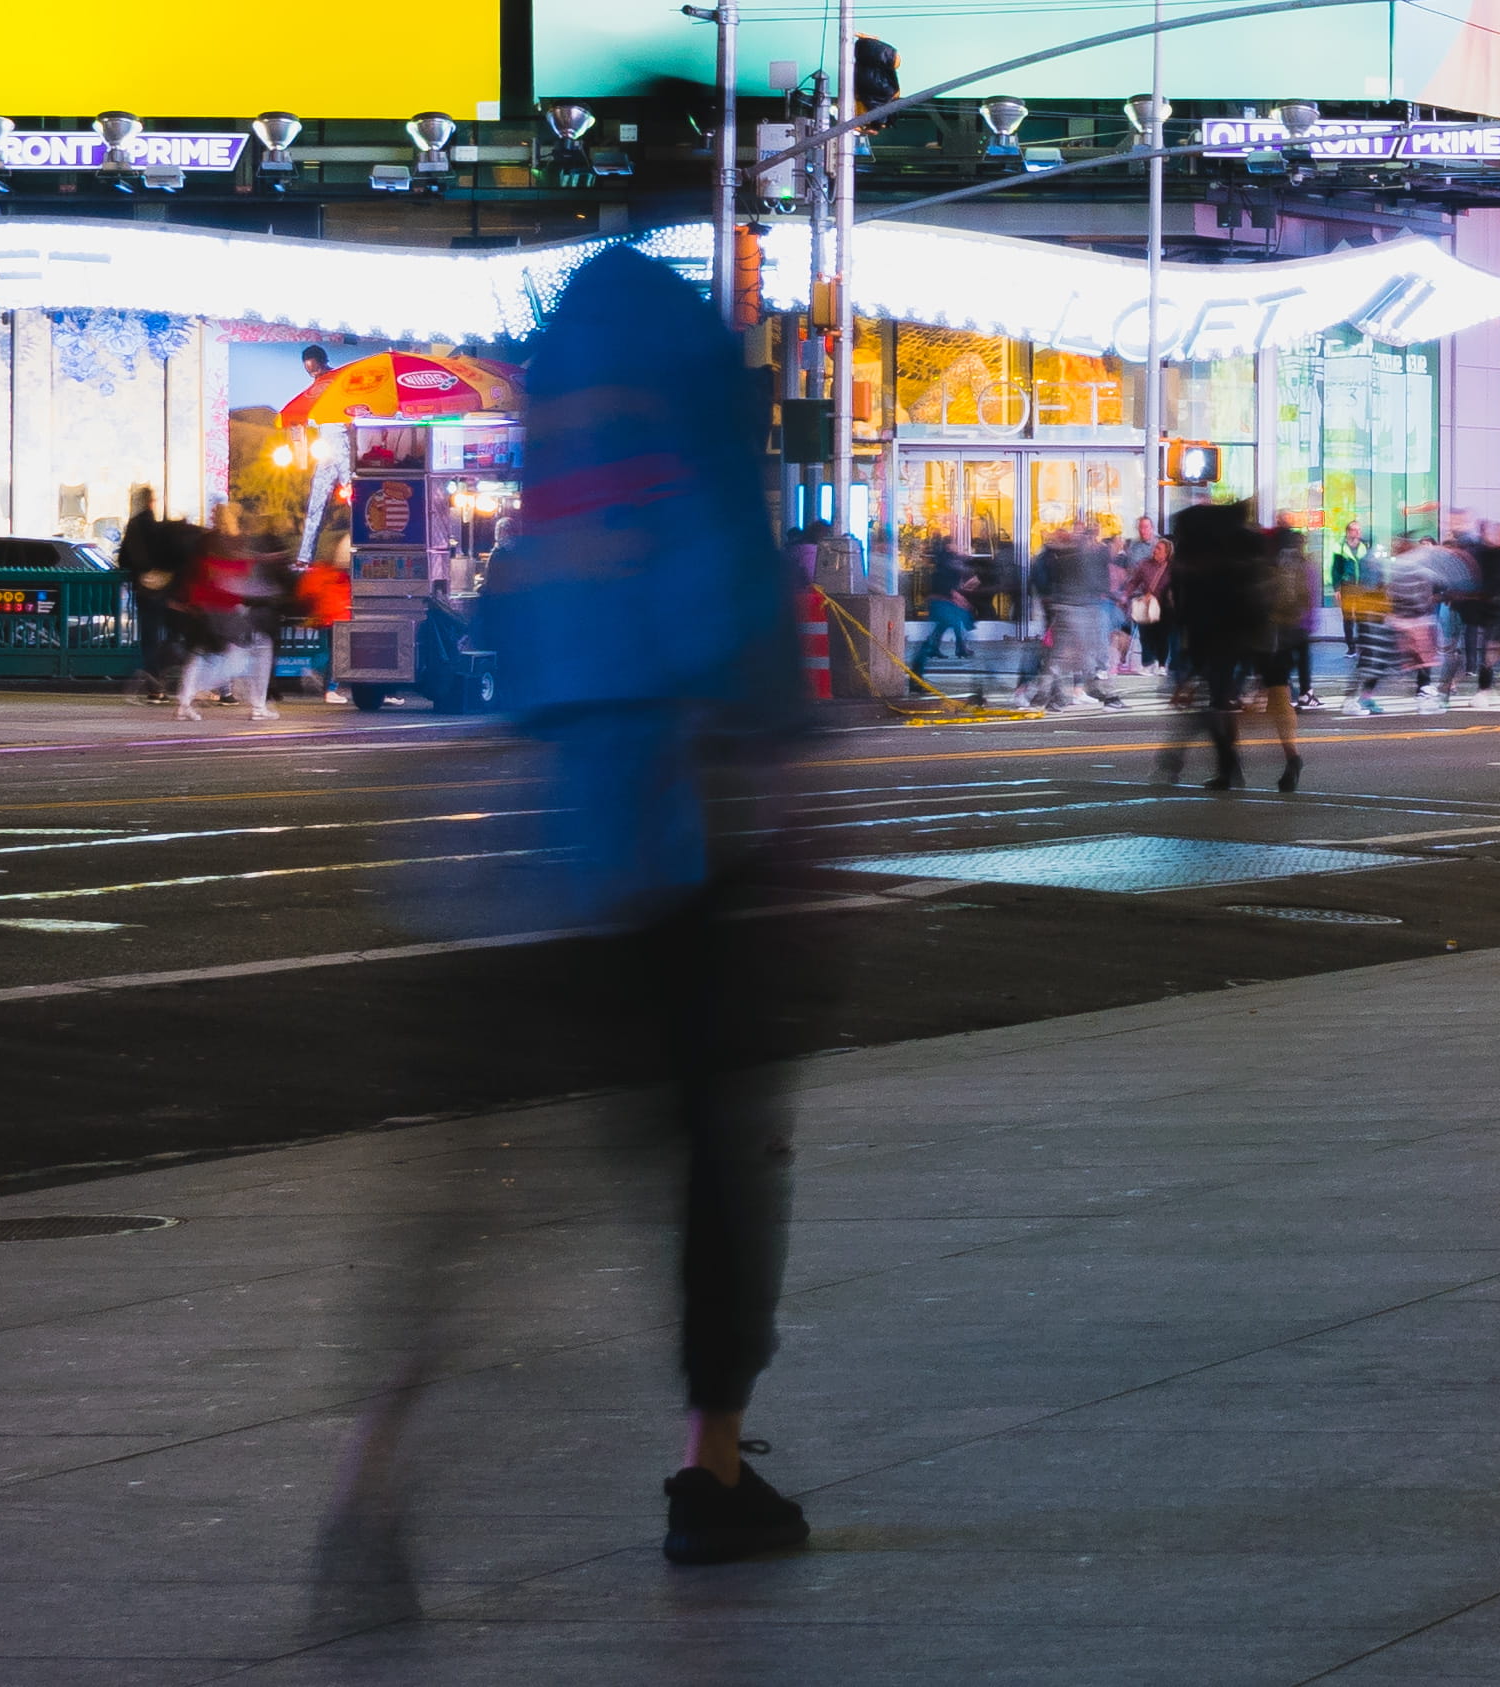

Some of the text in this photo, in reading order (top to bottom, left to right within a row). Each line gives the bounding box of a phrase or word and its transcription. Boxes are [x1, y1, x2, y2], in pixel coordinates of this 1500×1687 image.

[131, 137, 232, 167] PRIME
[1052, 285, 1308, 362] LOFT
[941, 381, 1118, 437] LOFT
